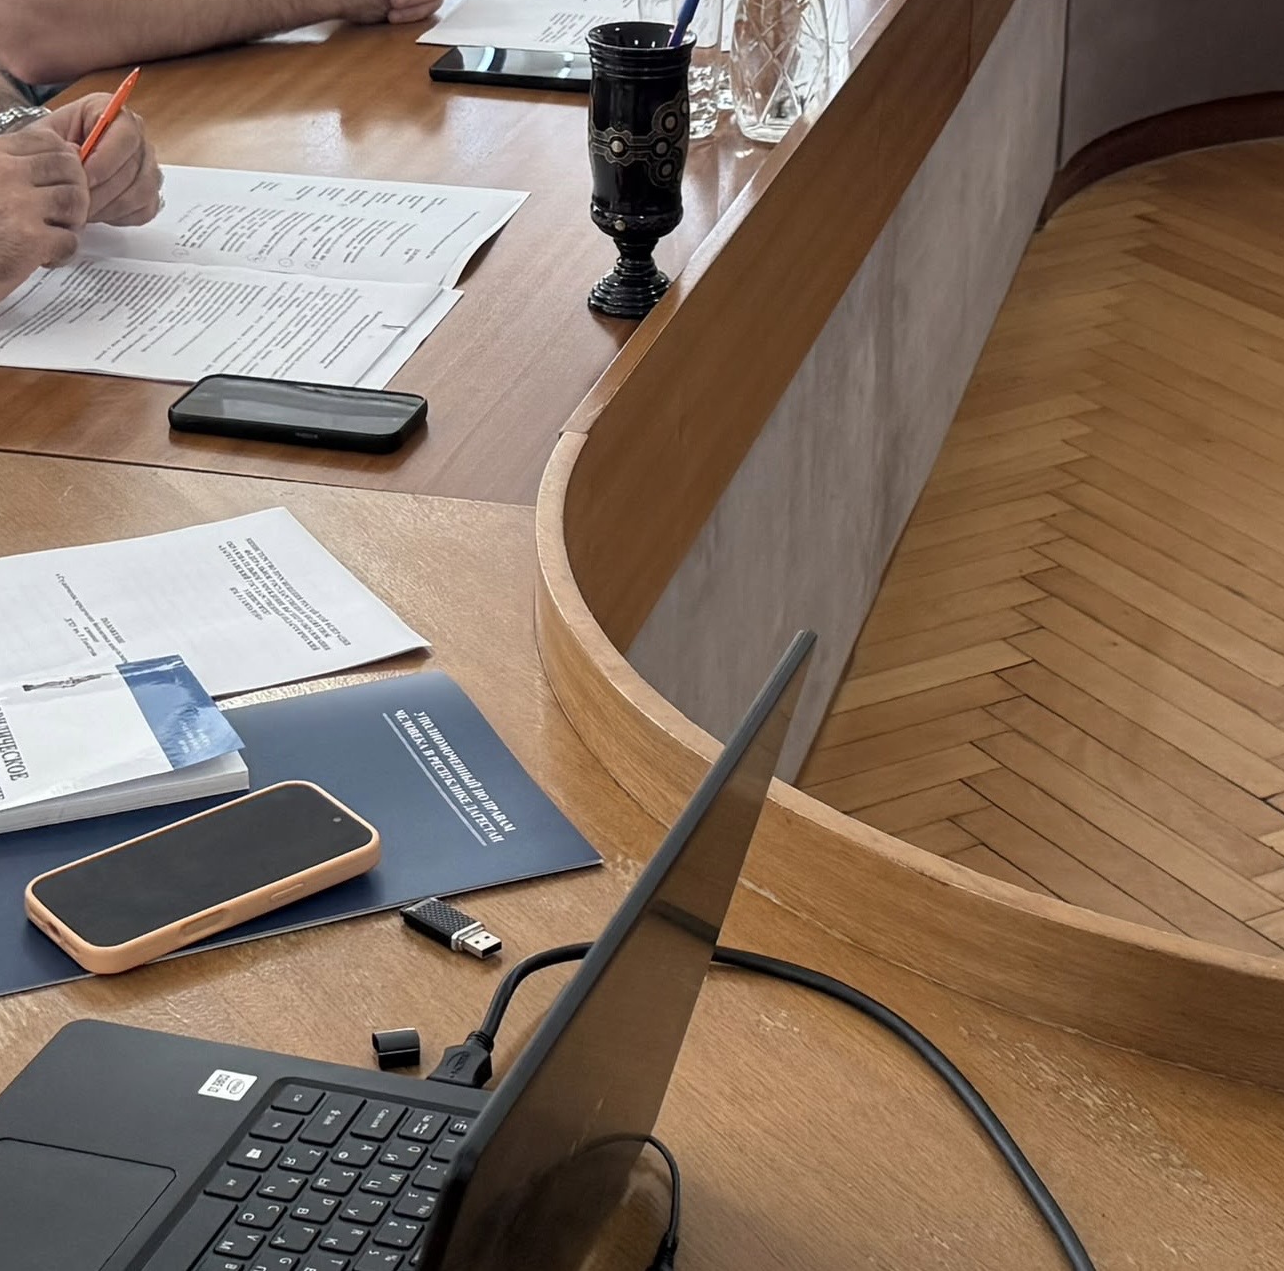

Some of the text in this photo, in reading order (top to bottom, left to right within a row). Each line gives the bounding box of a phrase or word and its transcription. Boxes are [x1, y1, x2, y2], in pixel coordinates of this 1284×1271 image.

[393, 708, 507, 844] ЧЕЛОВЕКА В РЕСПУБЛИКЕ ДАГЕСТАН
[413, 710, 518, 833] УПОЛНОМОЧЕННЫЙ ПО ПРАВАМ
